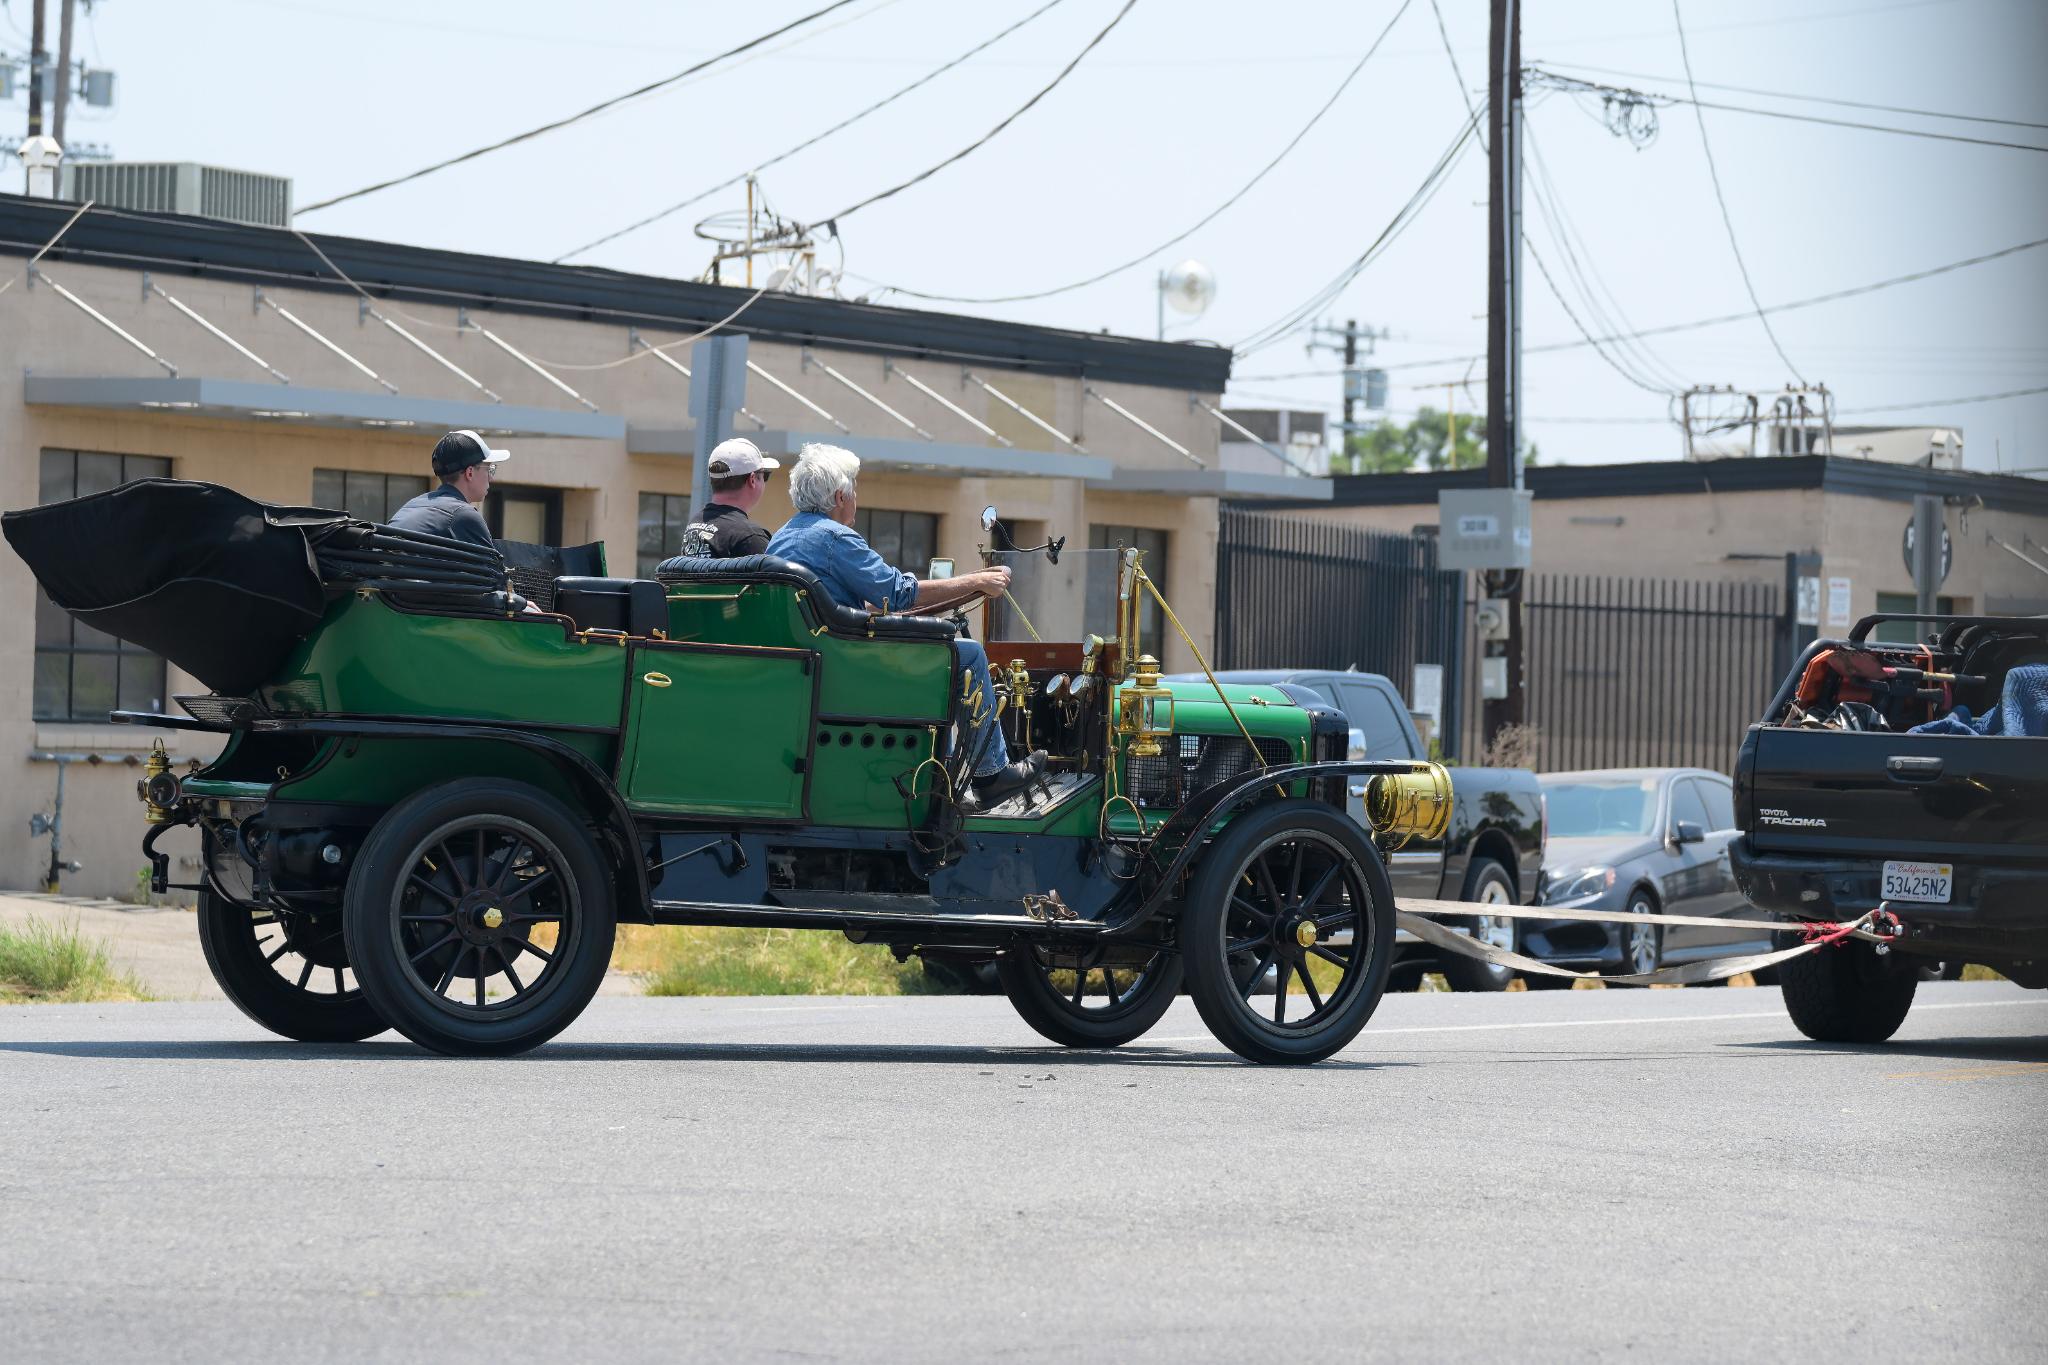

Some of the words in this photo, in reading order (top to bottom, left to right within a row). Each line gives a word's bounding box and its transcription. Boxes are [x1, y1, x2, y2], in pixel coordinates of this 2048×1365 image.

[1759, 808, 1789, 817] TOYOTA
[1760, 816, 1827, 827] TACOMA
[1897, 864, 1937, 876] California
[1886, 875, 1947, 897] 53425N2
